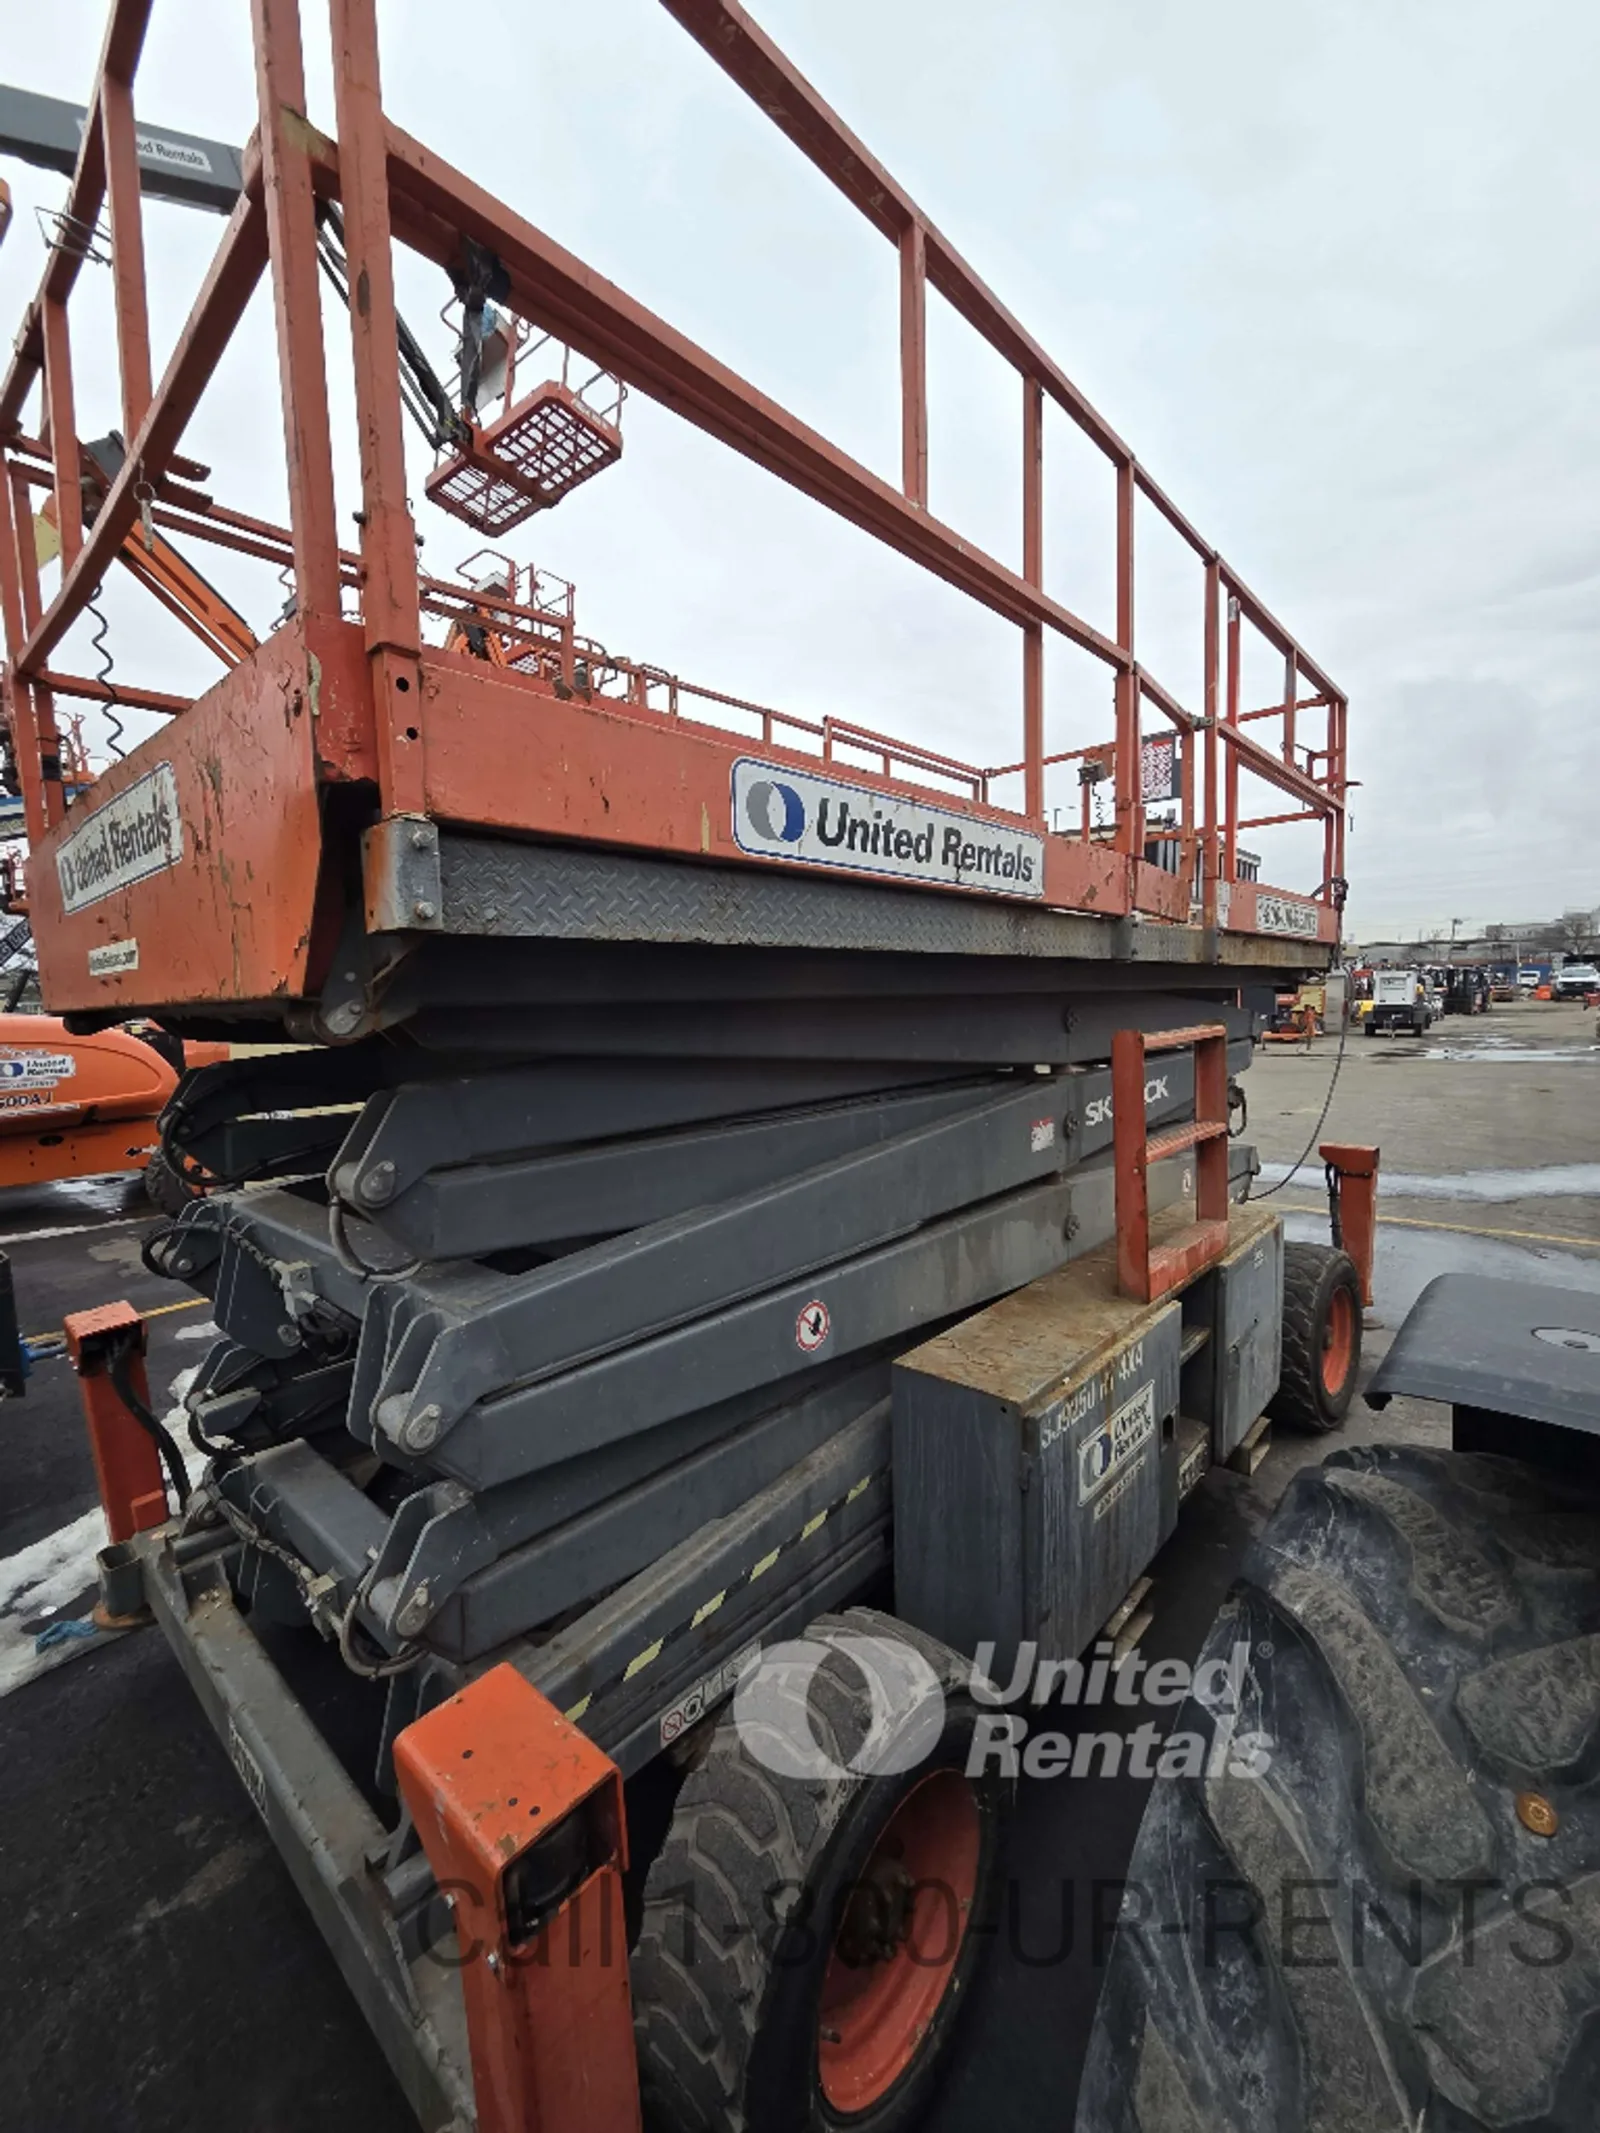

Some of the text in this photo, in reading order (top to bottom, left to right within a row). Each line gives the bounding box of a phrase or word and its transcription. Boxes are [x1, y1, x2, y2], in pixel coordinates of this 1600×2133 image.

[108, 792, 172, 870] Rentals
[817, 797, 1036, 882] United Rentals
[1085, 1075, 1168, 1127] SKCK
